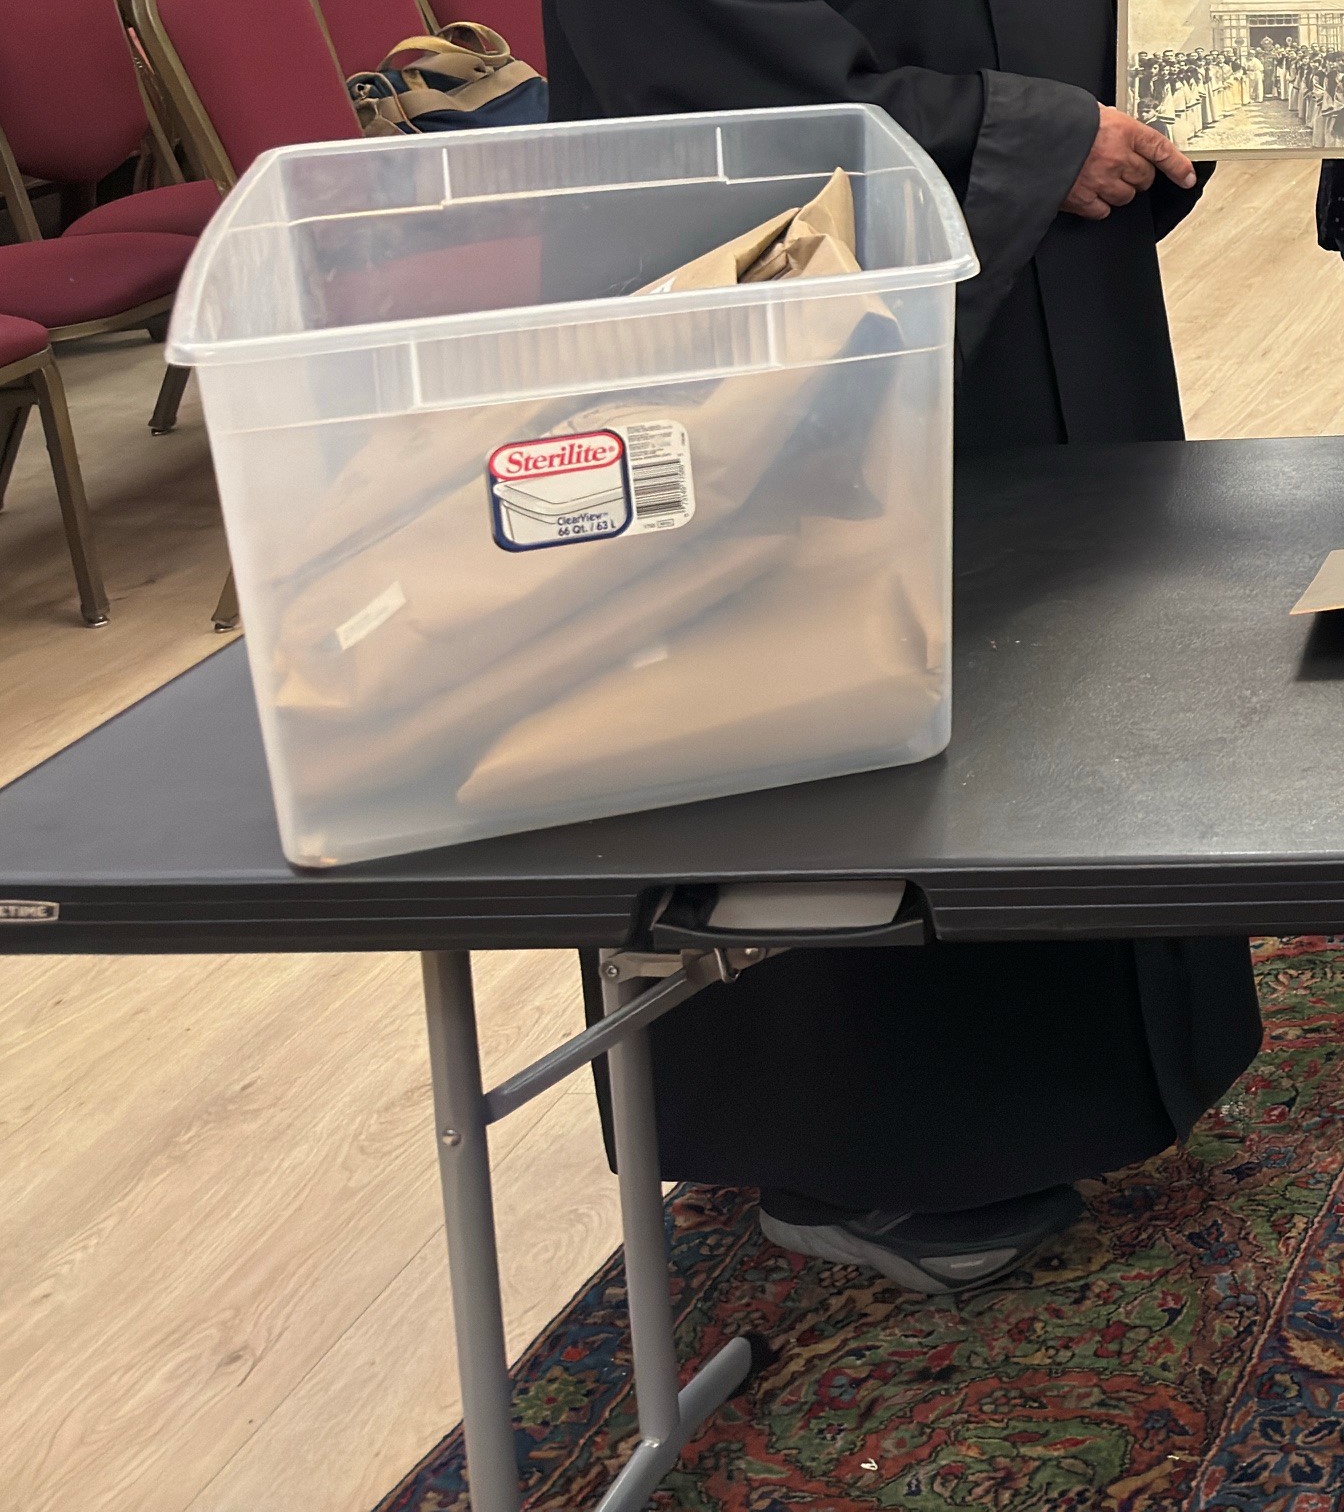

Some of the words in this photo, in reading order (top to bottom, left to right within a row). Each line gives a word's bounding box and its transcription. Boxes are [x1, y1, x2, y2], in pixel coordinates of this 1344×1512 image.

[558, 527, 571, 537] 66
[573, 523, 589, 535] Qt.
[596, 519, 609, 531] 63
[610, 518, 617, 529] L
